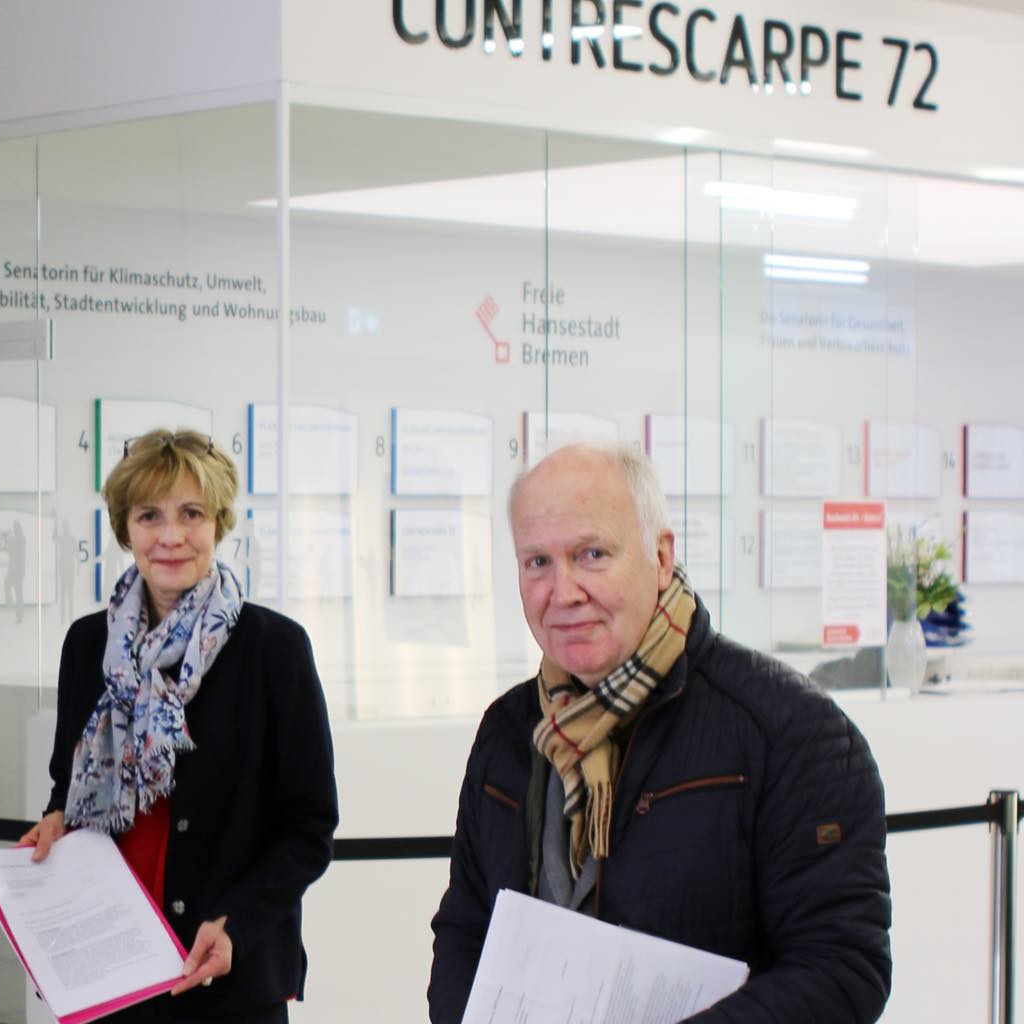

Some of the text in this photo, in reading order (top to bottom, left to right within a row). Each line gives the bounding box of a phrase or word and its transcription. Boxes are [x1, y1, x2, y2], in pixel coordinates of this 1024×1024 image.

[882, 36, 939, 111] 72
[83, 265, 105, 284] für
[109, 267, 203, 292] Klimaschutz,
[206, 272, 267, 294] Umwelt,
[522, 281, 566, 305] Freie
[54, 292, 187, 321] Stadtentwicklung
[192, 301, 220, 317] und
[522, 312, 621, 339] Hansestadt
[522, 343, 590, 367] Bremen
[78, 431, 89, 452] 4
[232, 433, 243, 455] 6
[375, 435, 385, 458] 8
[508, 437, 519, 459] 9
[78, 539, 89, 563] 5
[232, 538, 242, 558] 7
